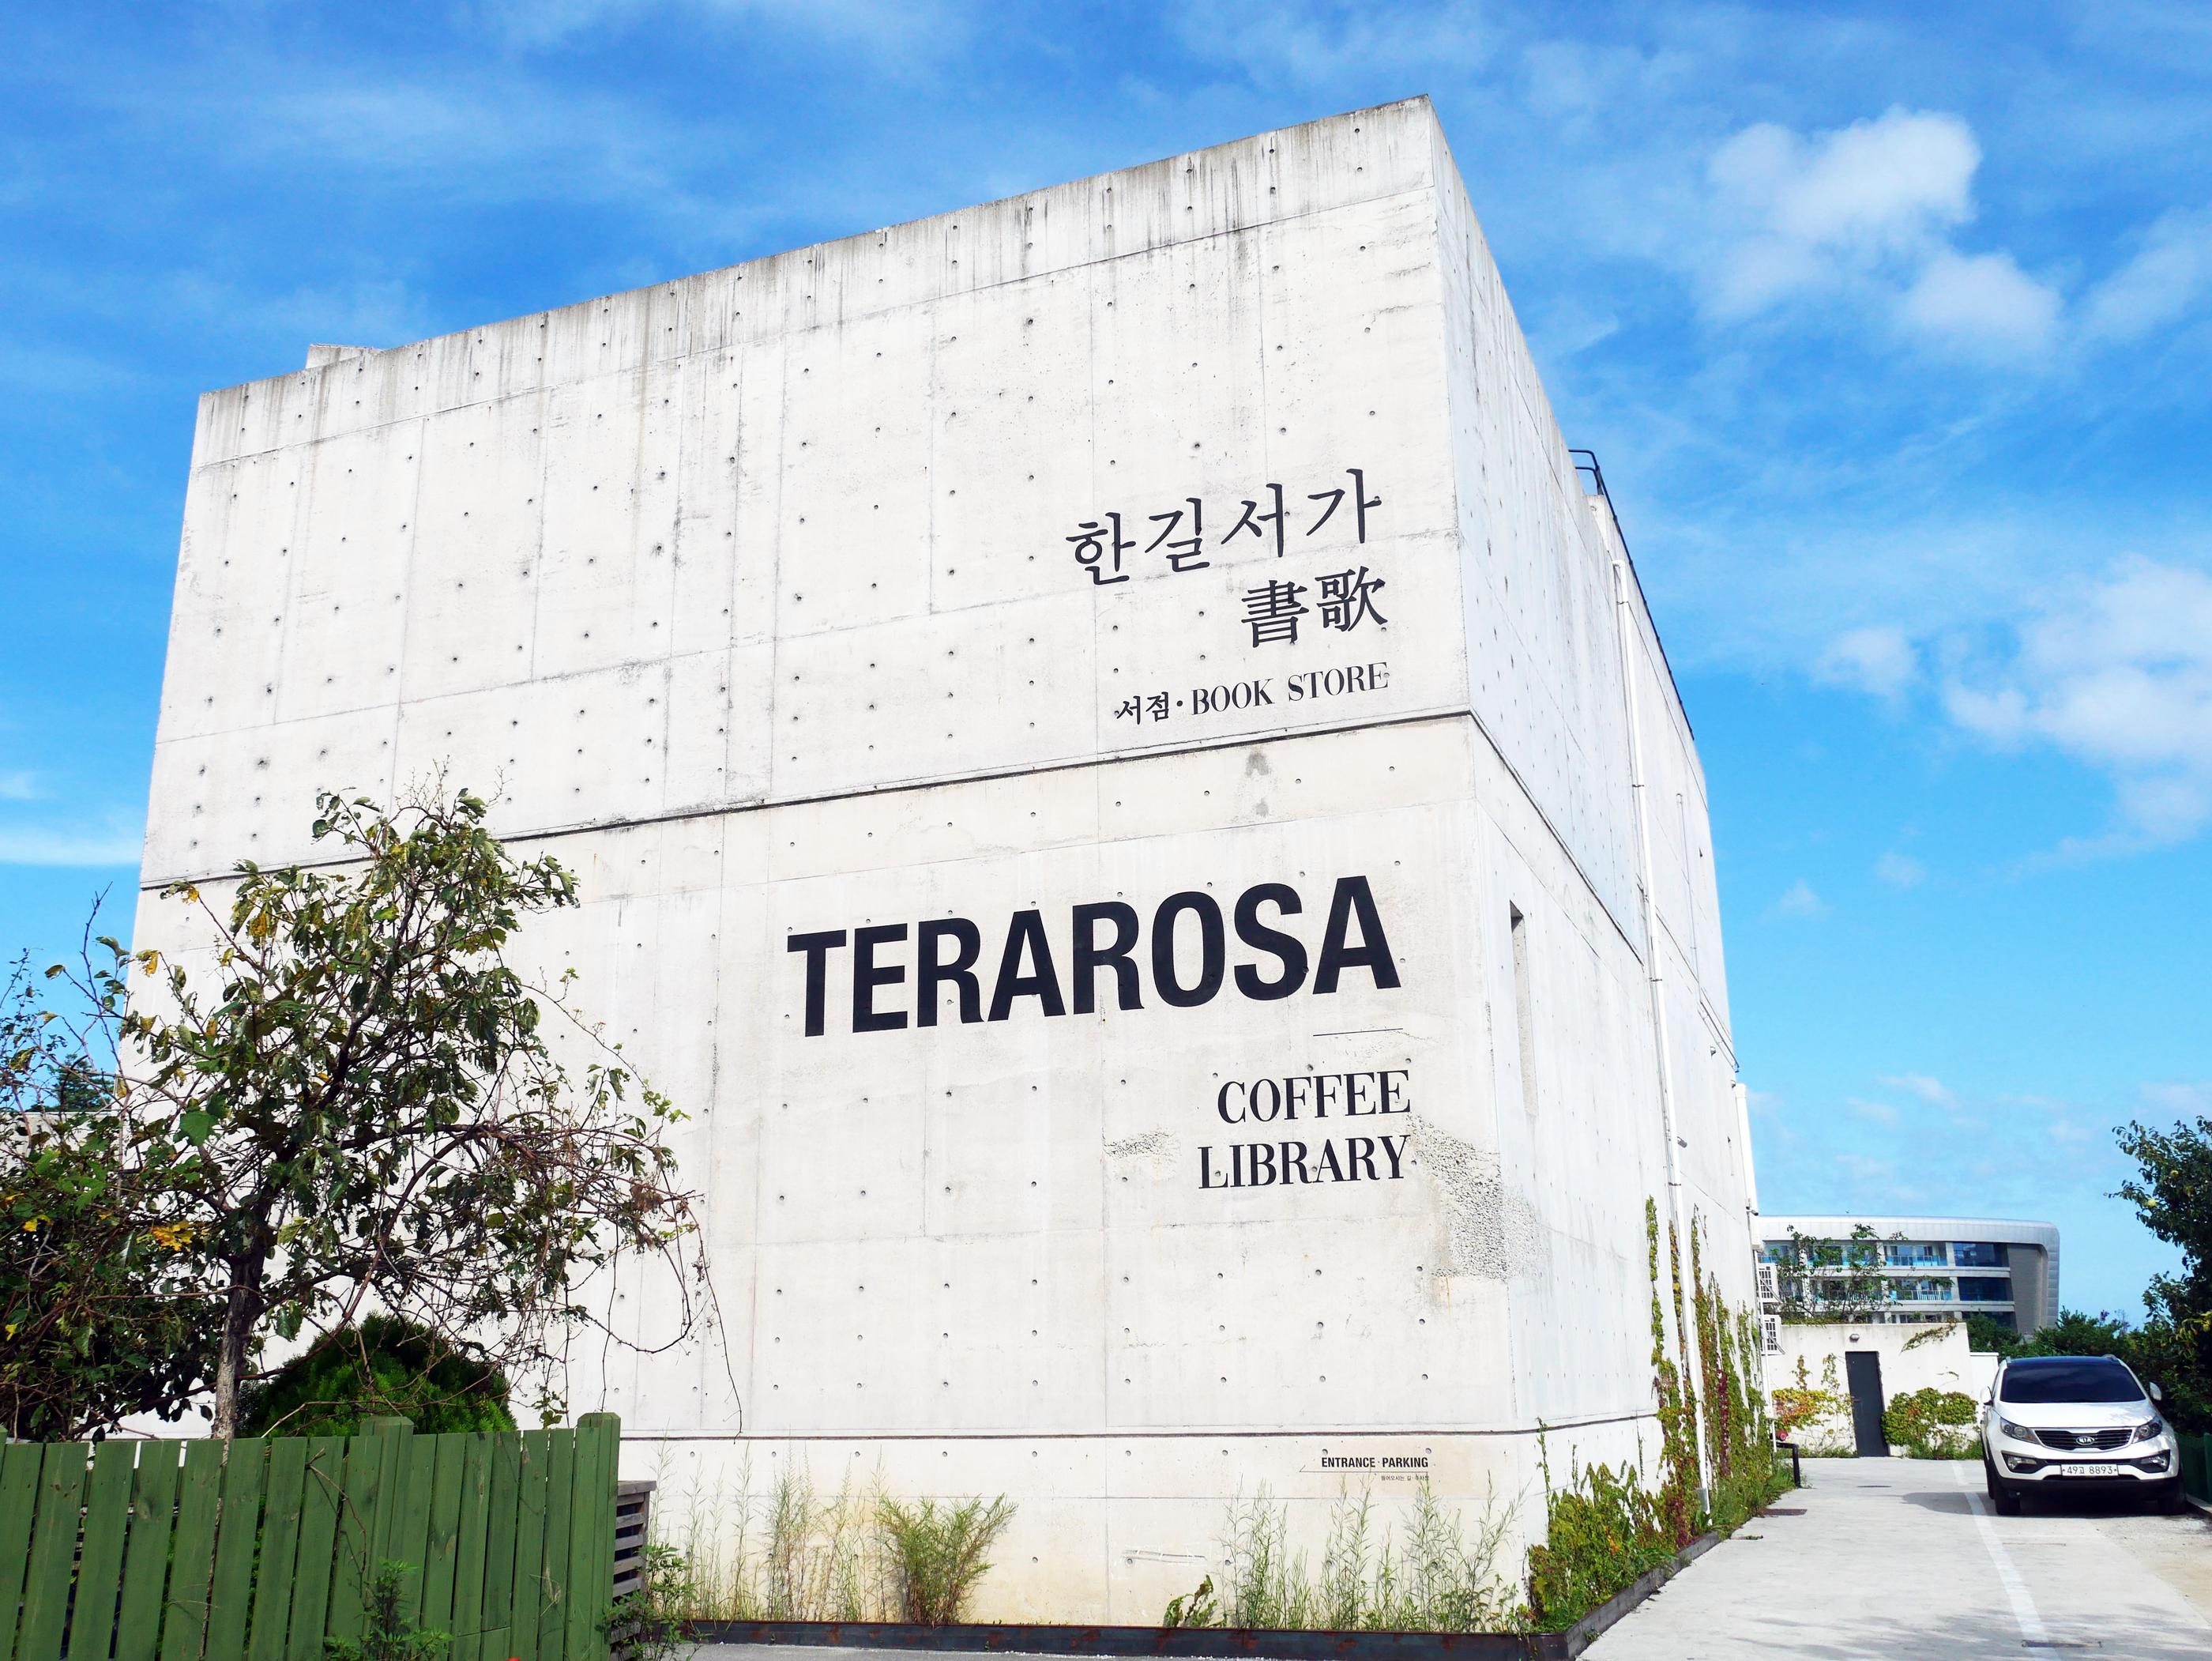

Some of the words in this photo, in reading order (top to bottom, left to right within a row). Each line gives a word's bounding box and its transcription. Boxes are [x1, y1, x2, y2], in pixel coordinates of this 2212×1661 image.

[1066, 469, 1382, 586] 한길서가
[1241, 565, 1388, 648] 書歌
[1191, 678, 1274, 715] BOOK
[1288, 661, 1389, 701] STORE
[788, 876, 1401, 1038] TERAROSA
[1217, 1069, 1411, 1124] COFFEE
[1197, 1134, 1411, 1189] LIBRARY
[1322, 1457, 1376, 1468] ENTRANCE
[1382, 1457, 1428, 1468] PARKING
